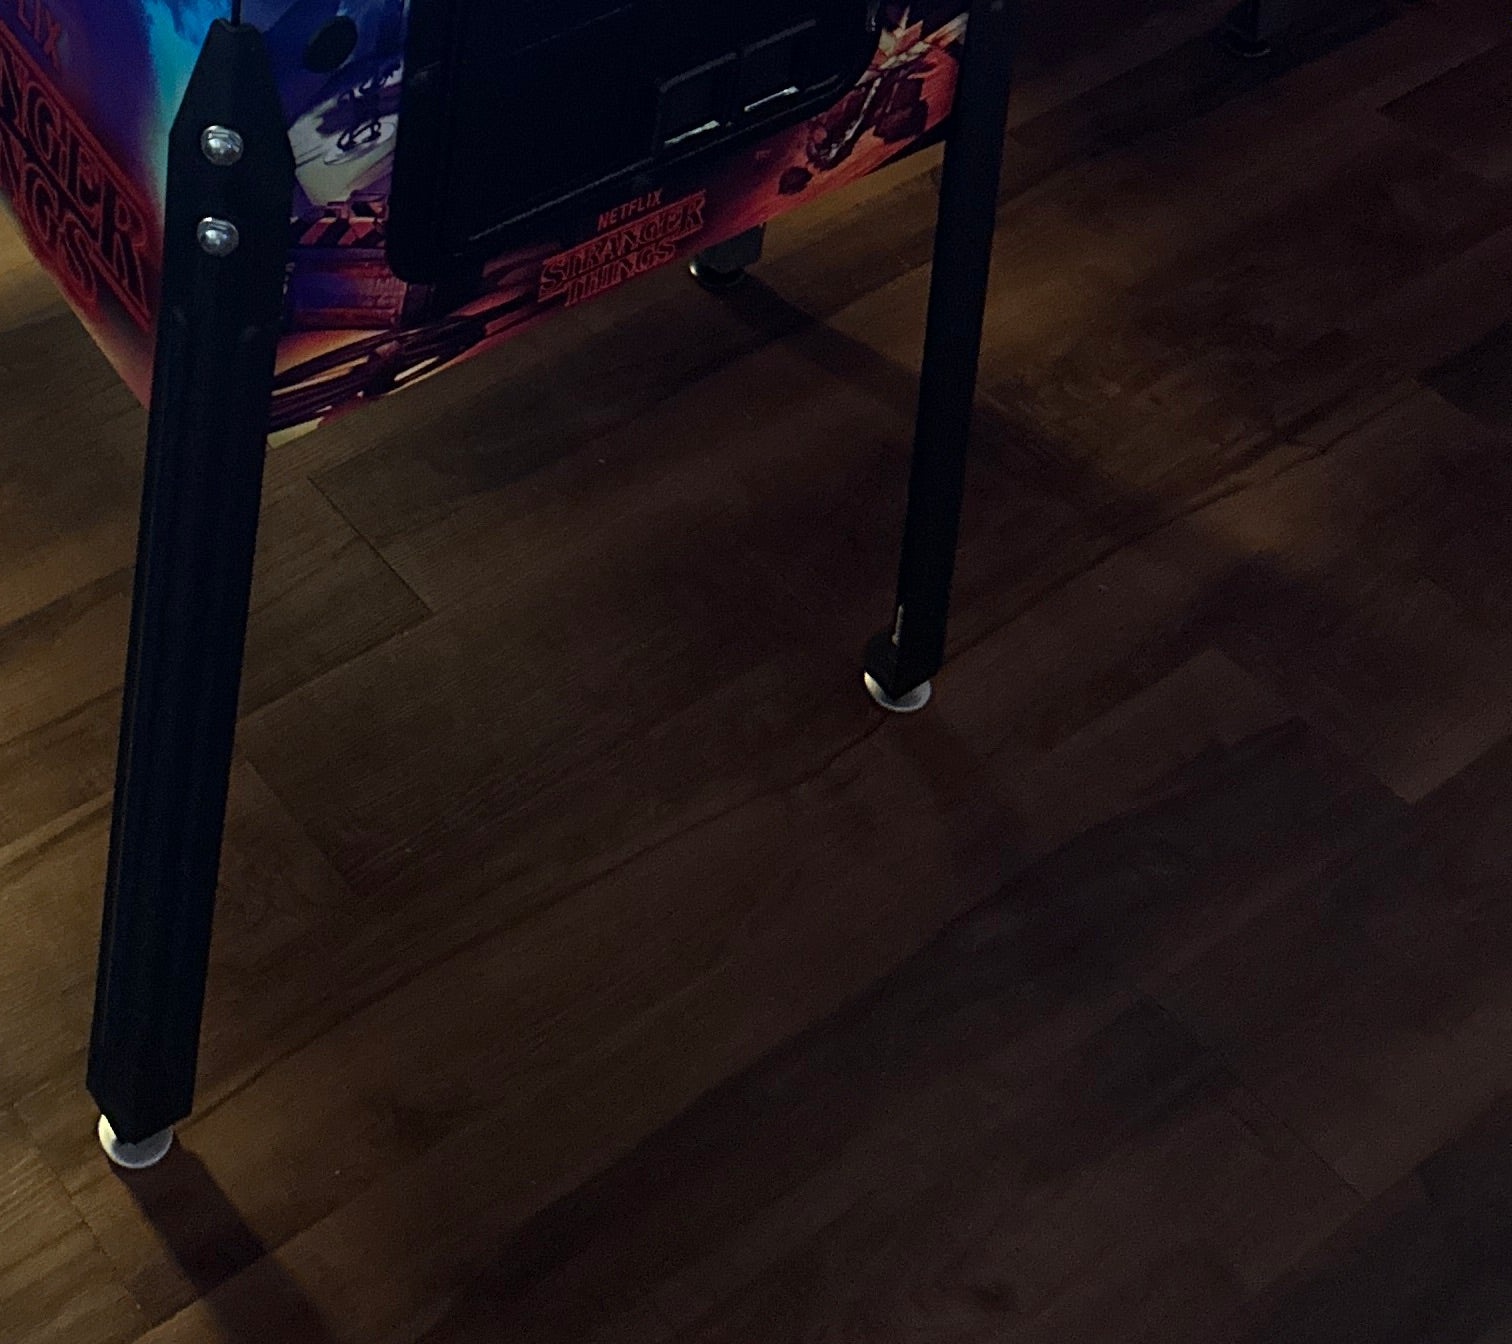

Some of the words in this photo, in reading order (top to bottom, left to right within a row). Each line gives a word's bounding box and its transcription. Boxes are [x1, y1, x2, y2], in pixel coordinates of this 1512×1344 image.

[540, 192, 705, 292] STRANGER
[597, 188, 663, 232] NETFLIX
[565, 239, 676, 306] THINGS
